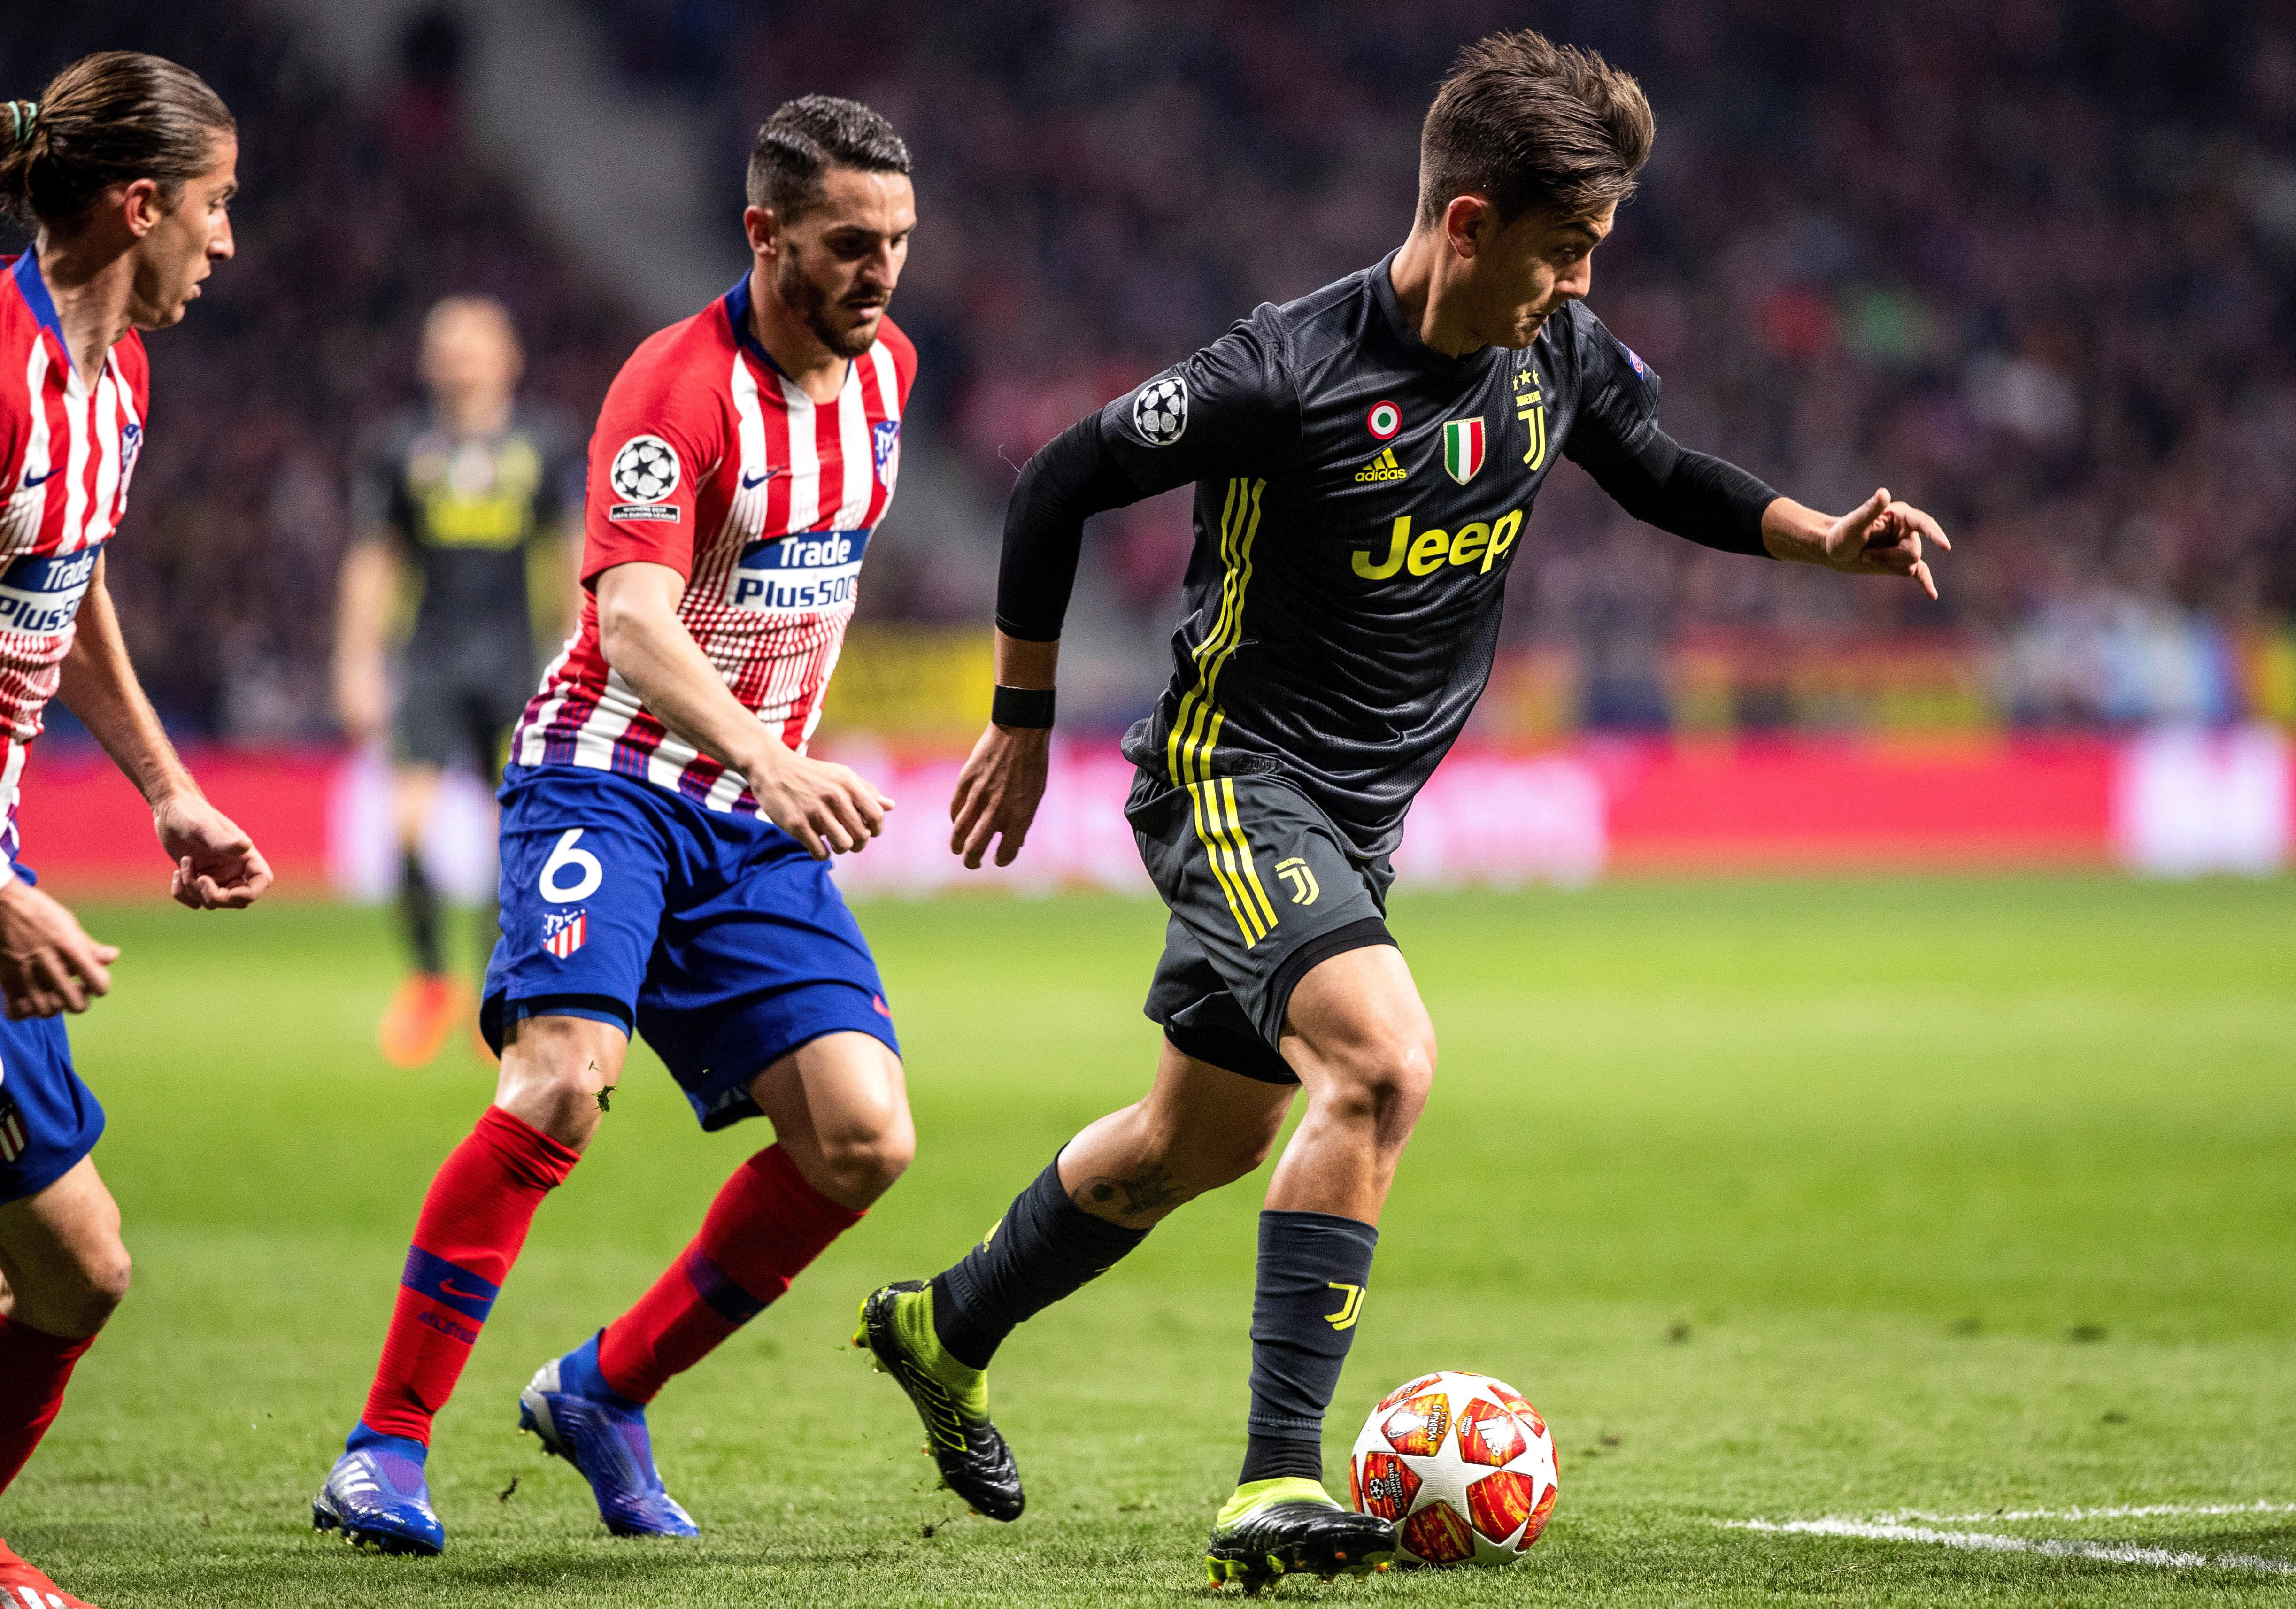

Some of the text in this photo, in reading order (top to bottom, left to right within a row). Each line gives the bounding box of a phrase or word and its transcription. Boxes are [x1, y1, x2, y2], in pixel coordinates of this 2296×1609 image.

[1355, 468, 1407, 482] adidas
[779, 532, 852, 567] Trade
[1351, 509, 1523, 580] Jeep
[42, 549, 94, 591] Trade
[539, 827, 603, 904] 6
[1438, 1411, 1448, 1434] FINAL
[1388, 1463, 1401, 1508] CHAMPIONS
[1395, 1473, 1403, 1496] LEAGUE
